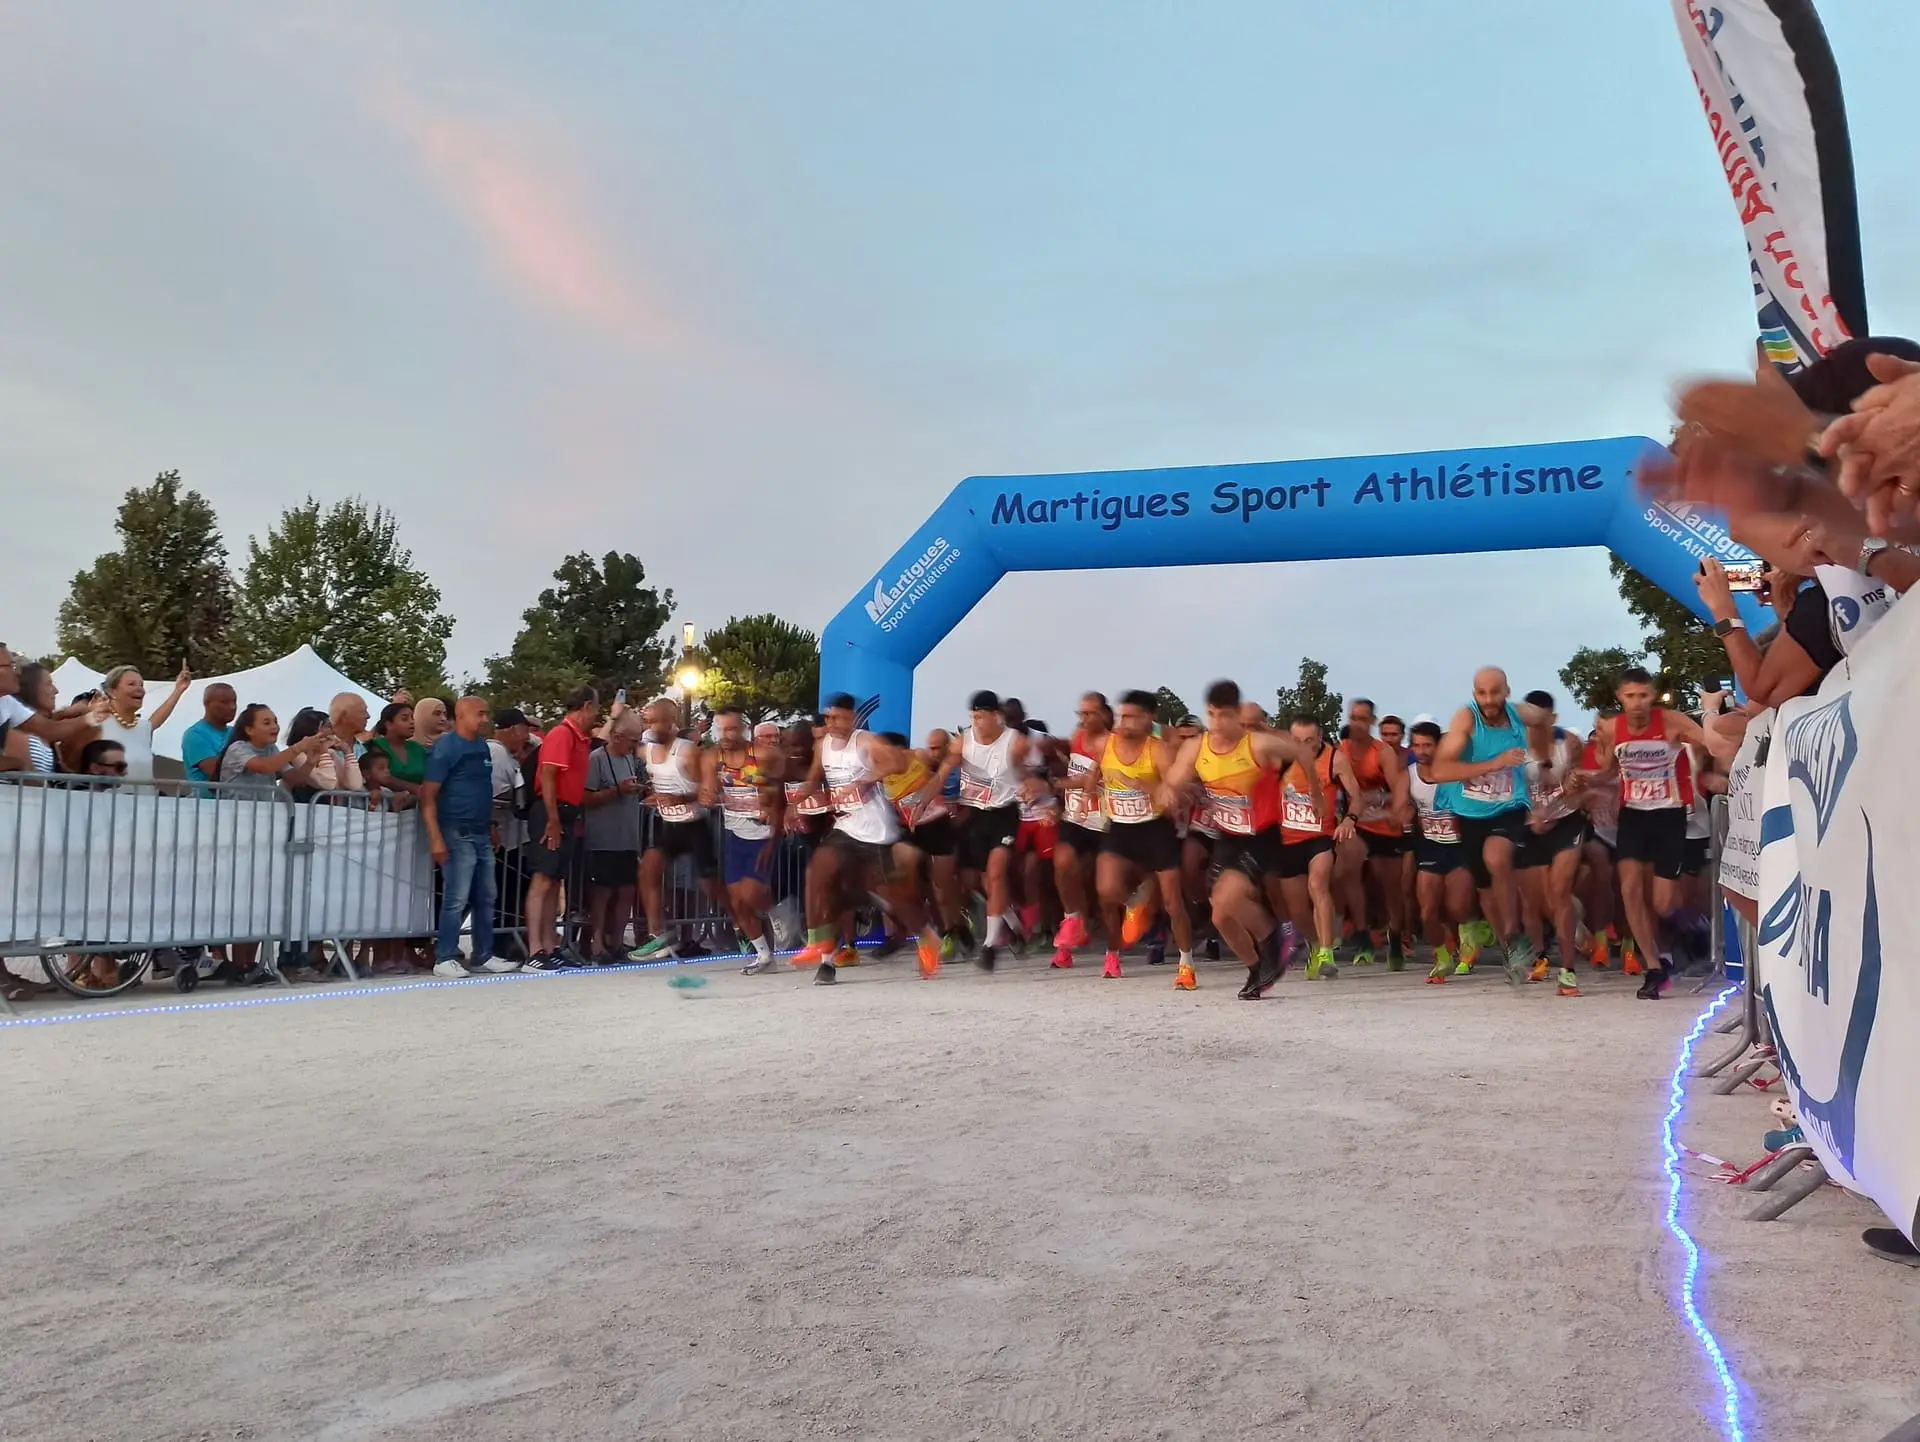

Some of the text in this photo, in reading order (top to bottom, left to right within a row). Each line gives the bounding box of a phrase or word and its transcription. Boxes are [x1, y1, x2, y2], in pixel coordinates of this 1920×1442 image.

[991, 462, 1604, 531] Martigues Sport Athlétisme
[1643, 508, 1683, 543] Sport
[864, 537, 947, 623] Martigues
[881, 548, 961, 632] Sport Athlétisme
